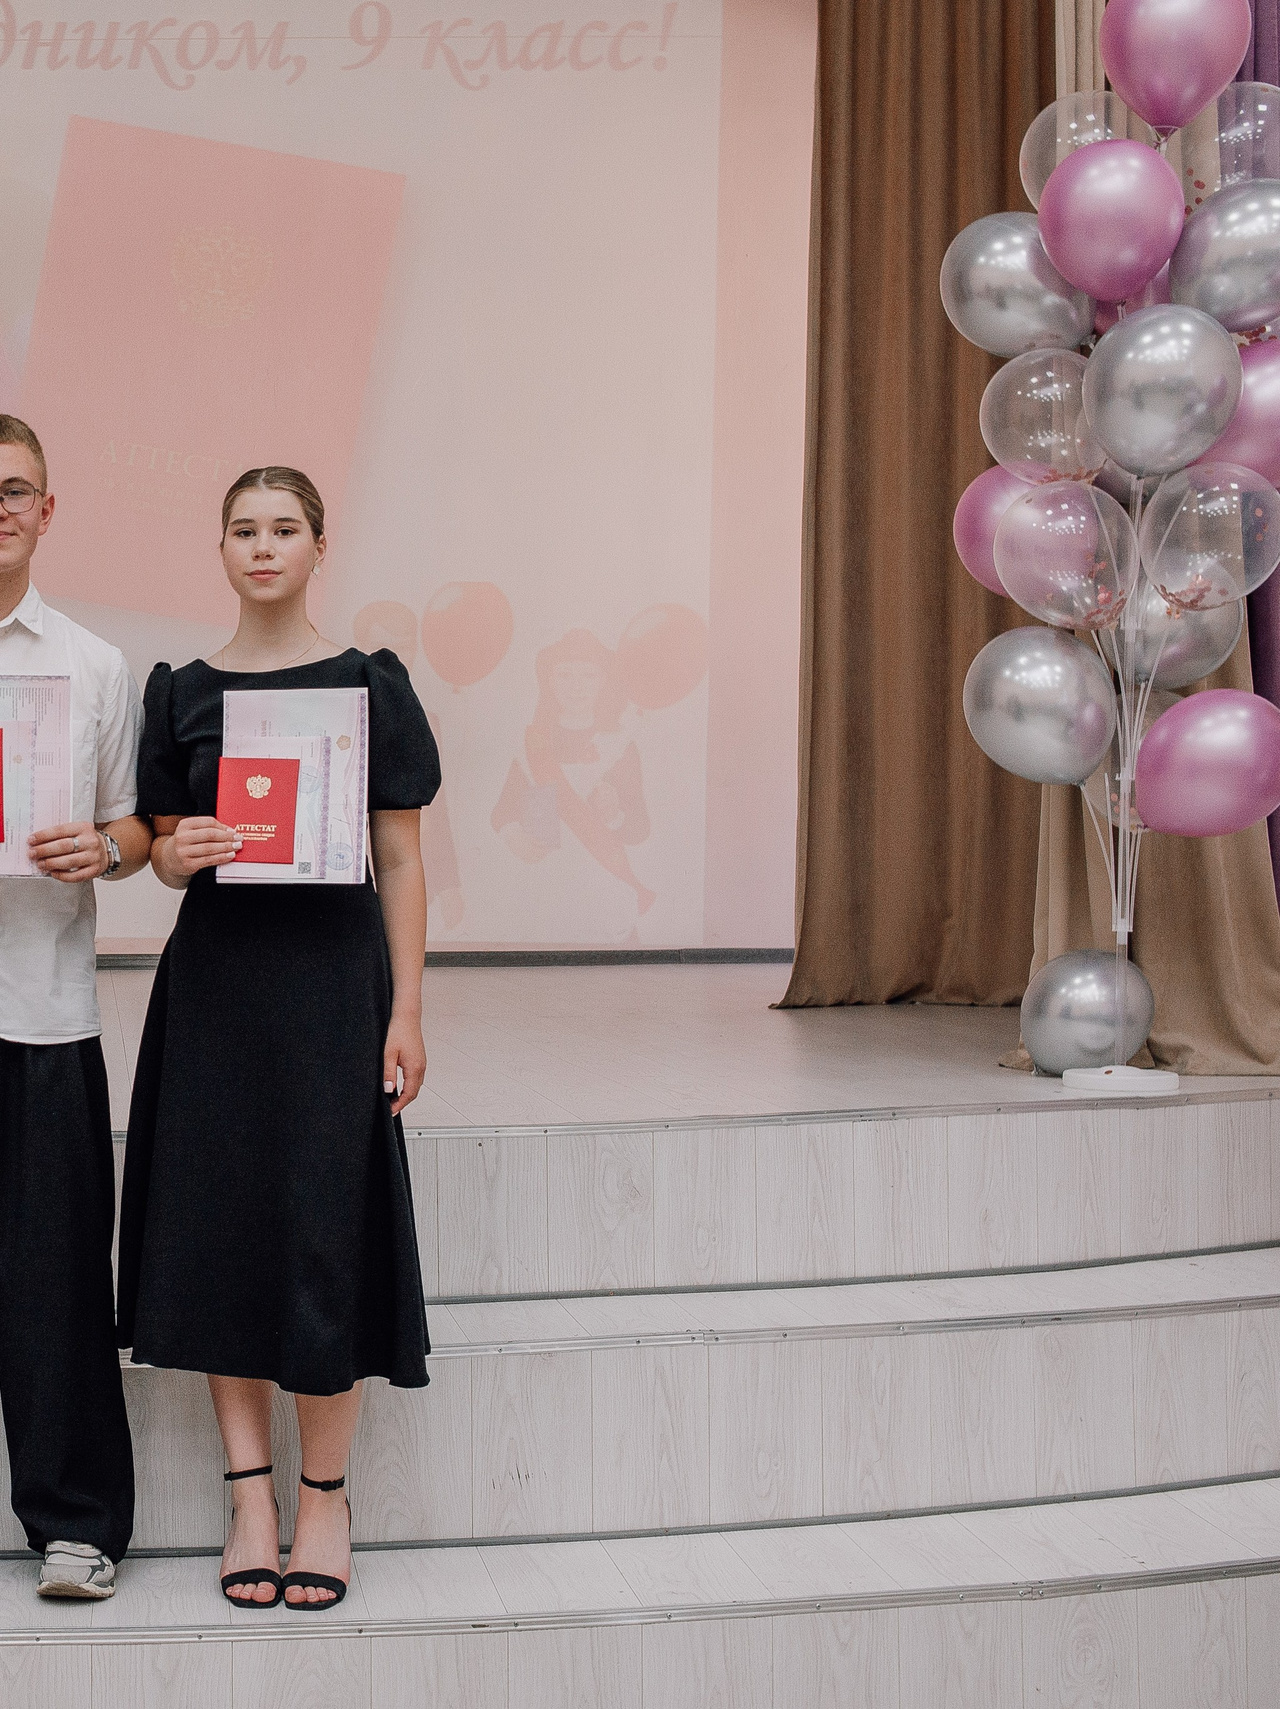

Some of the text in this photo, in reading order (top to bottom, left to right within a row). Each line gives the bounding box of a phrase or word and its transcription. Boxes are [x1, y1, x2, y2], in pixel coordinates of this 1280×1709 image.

[340, 1, 393, 71] 9
[420, 2, 678, 91] класс!
[235, 824, 277, 832] АТТЕСТАТ
